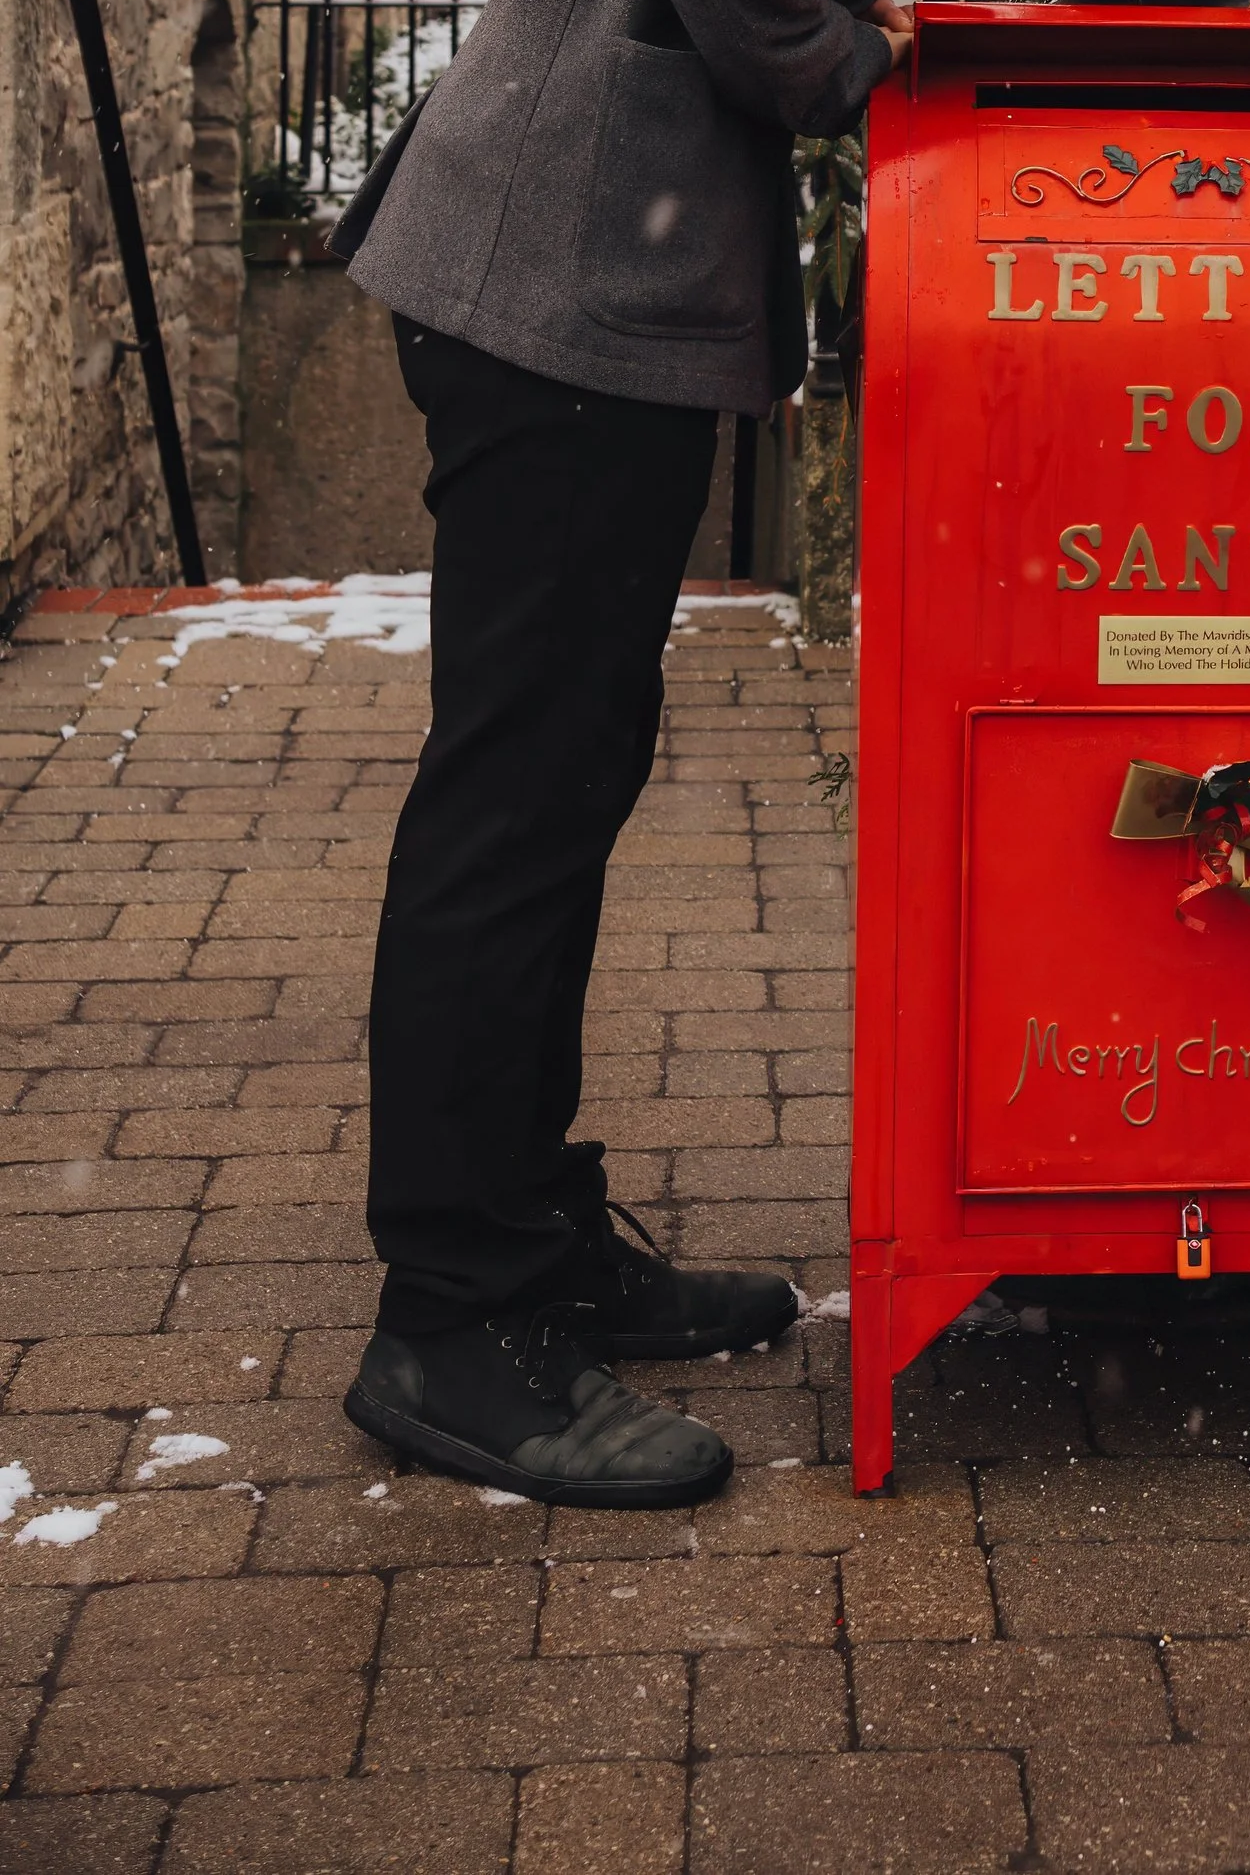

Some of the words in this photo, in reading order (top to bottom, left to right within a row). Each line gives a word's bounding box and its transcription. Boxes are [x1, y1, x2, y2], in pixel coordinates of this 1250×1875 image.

[1106, 630, 1156, 642] Donated
[1160, 630, 1174, 643] By
[1177, 630, 1199, 641] The
[1109, 646, 1120, 656] In
[1123, 645, 1161, 657] Loving
[1164, 645, 1214, 657] Memory
[1217, 644, 1229, 655] of
[1232, 644, 1241, 655] A
[1126, 659, 1155, 670] Who
[1158, 659, 1192, 670] Loved
[1196, 659, 1217, 670] The
[1007, 1017, 1160, 1126] Merry
